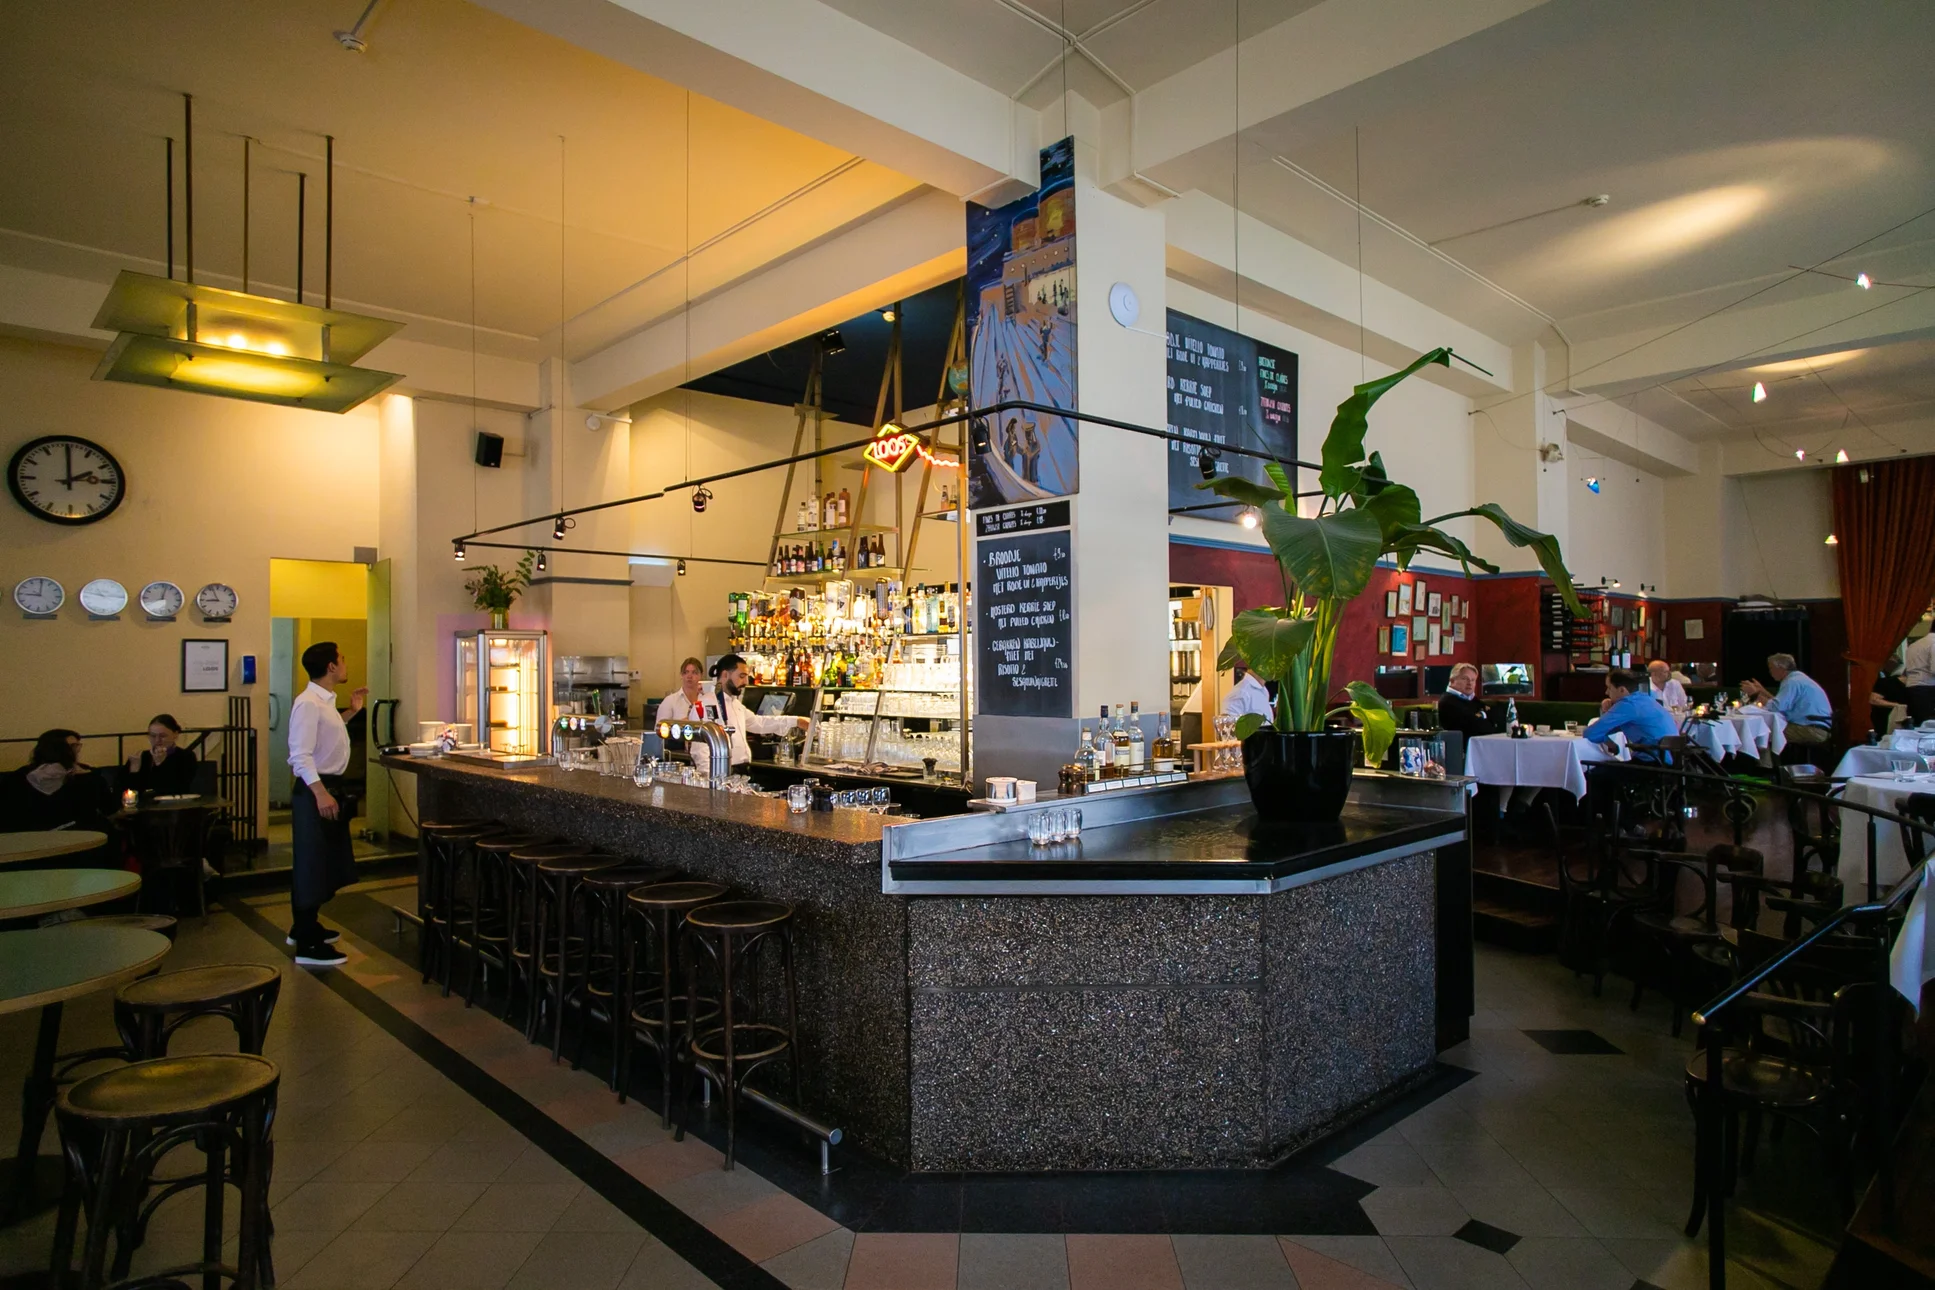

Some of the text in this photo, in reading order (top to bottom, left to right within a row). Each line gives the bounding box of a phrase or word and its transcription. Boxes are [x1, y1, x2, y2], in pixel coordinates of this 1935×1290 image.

[988, 549, 1021, 567] BROODJE
[1023, 562, 1047, 575] TONATO
[993, 582, 1004, 595] MET
[1007, 580, 1022, 592] RODE
[991, 600, 1056, 619] MOSTERD KERRIE SOEP
[1010, 617, 1029, 627] PULLED
[1031, 614, 1054, 628] CHICKEN
[1025, 650, 1034, 661] MET
[998, 664, 1019, 676] RISOTTO
